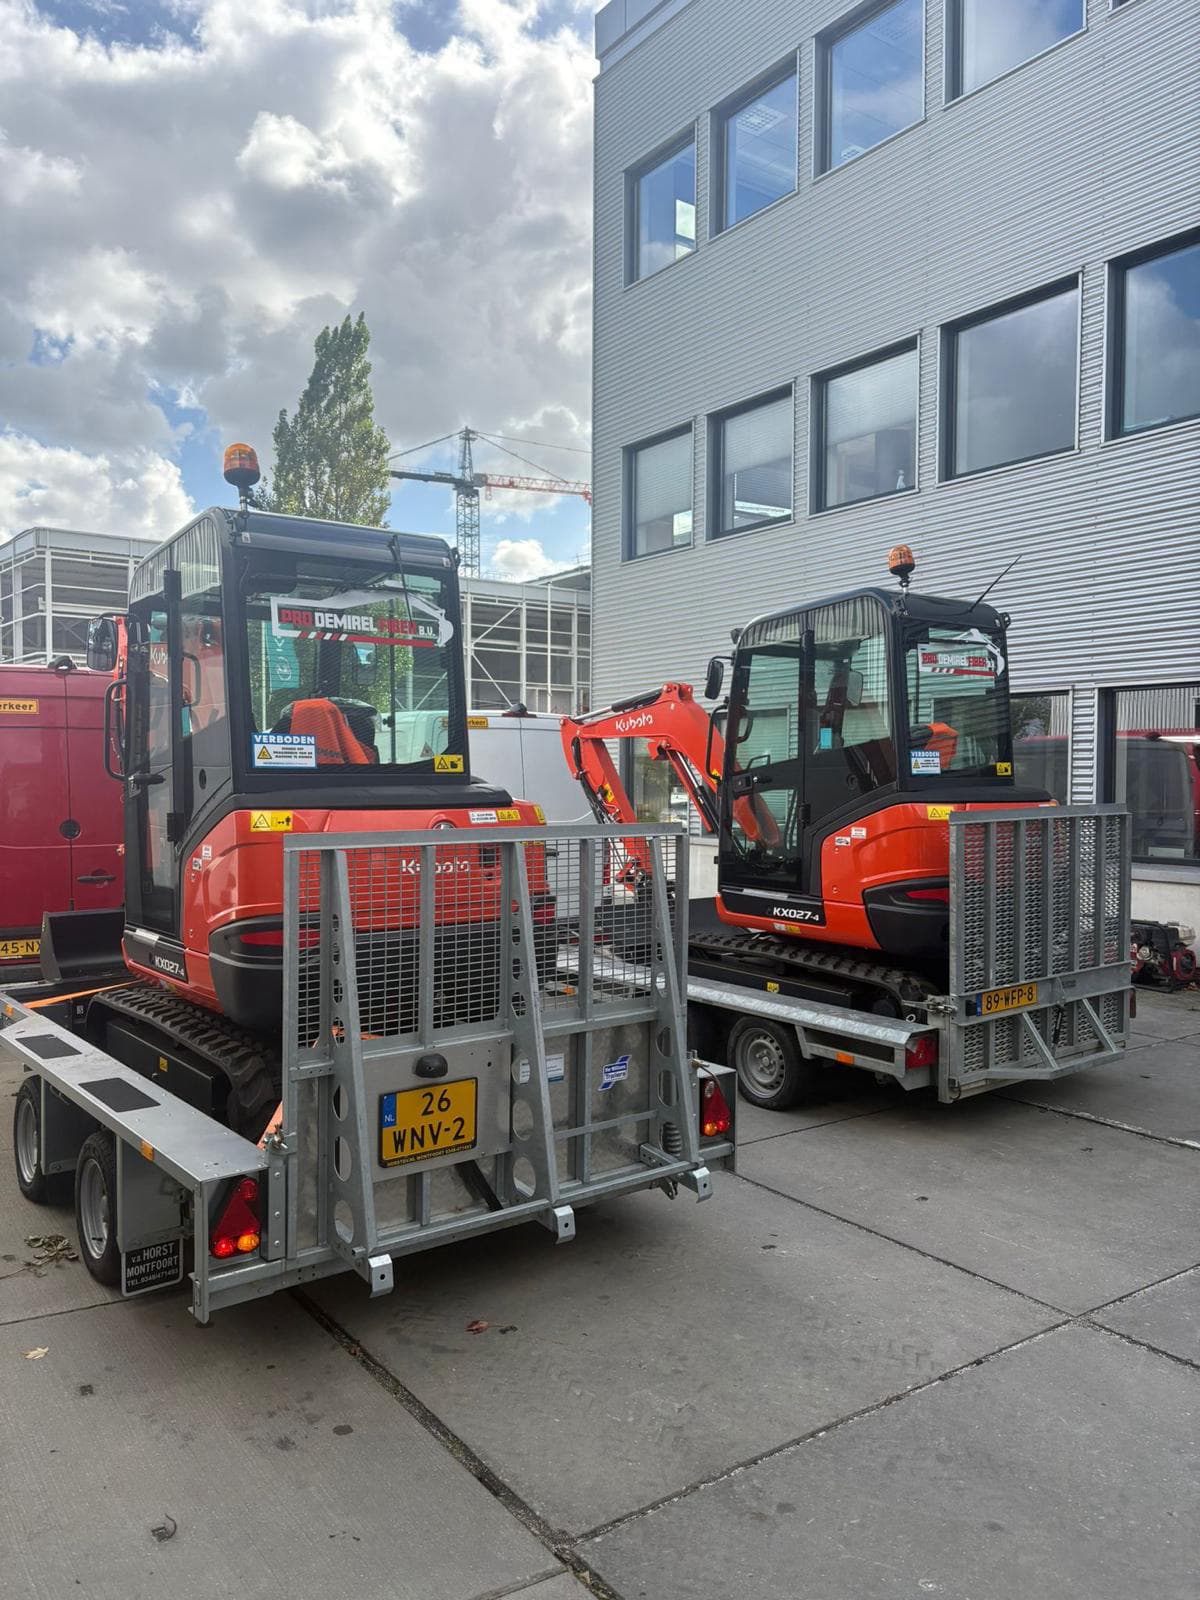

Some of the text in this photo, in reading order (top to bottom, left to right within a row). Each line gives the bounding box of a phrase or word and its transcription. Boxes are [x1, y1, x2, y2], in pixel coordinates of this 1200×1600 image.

[280, 608, 313, 626] PRO
[314, 612, 378, 632] DEMIREL
[615, 712, 653, 732] Kubota
[254, 734, 315, 744] VERBODEN
[773, 906, 819, 921] KX027-4
[986, 986, 1034, 1011] 89-WFP-8
[421, 1089, 451, 1116] 26
[384, 1114, 395, 1122] NL
[393, 1117, 465, 1154] WNV-2
[143, 1242, 175, 1261] HORST
[126, 1255, 178, 1278] MONTFOORT
